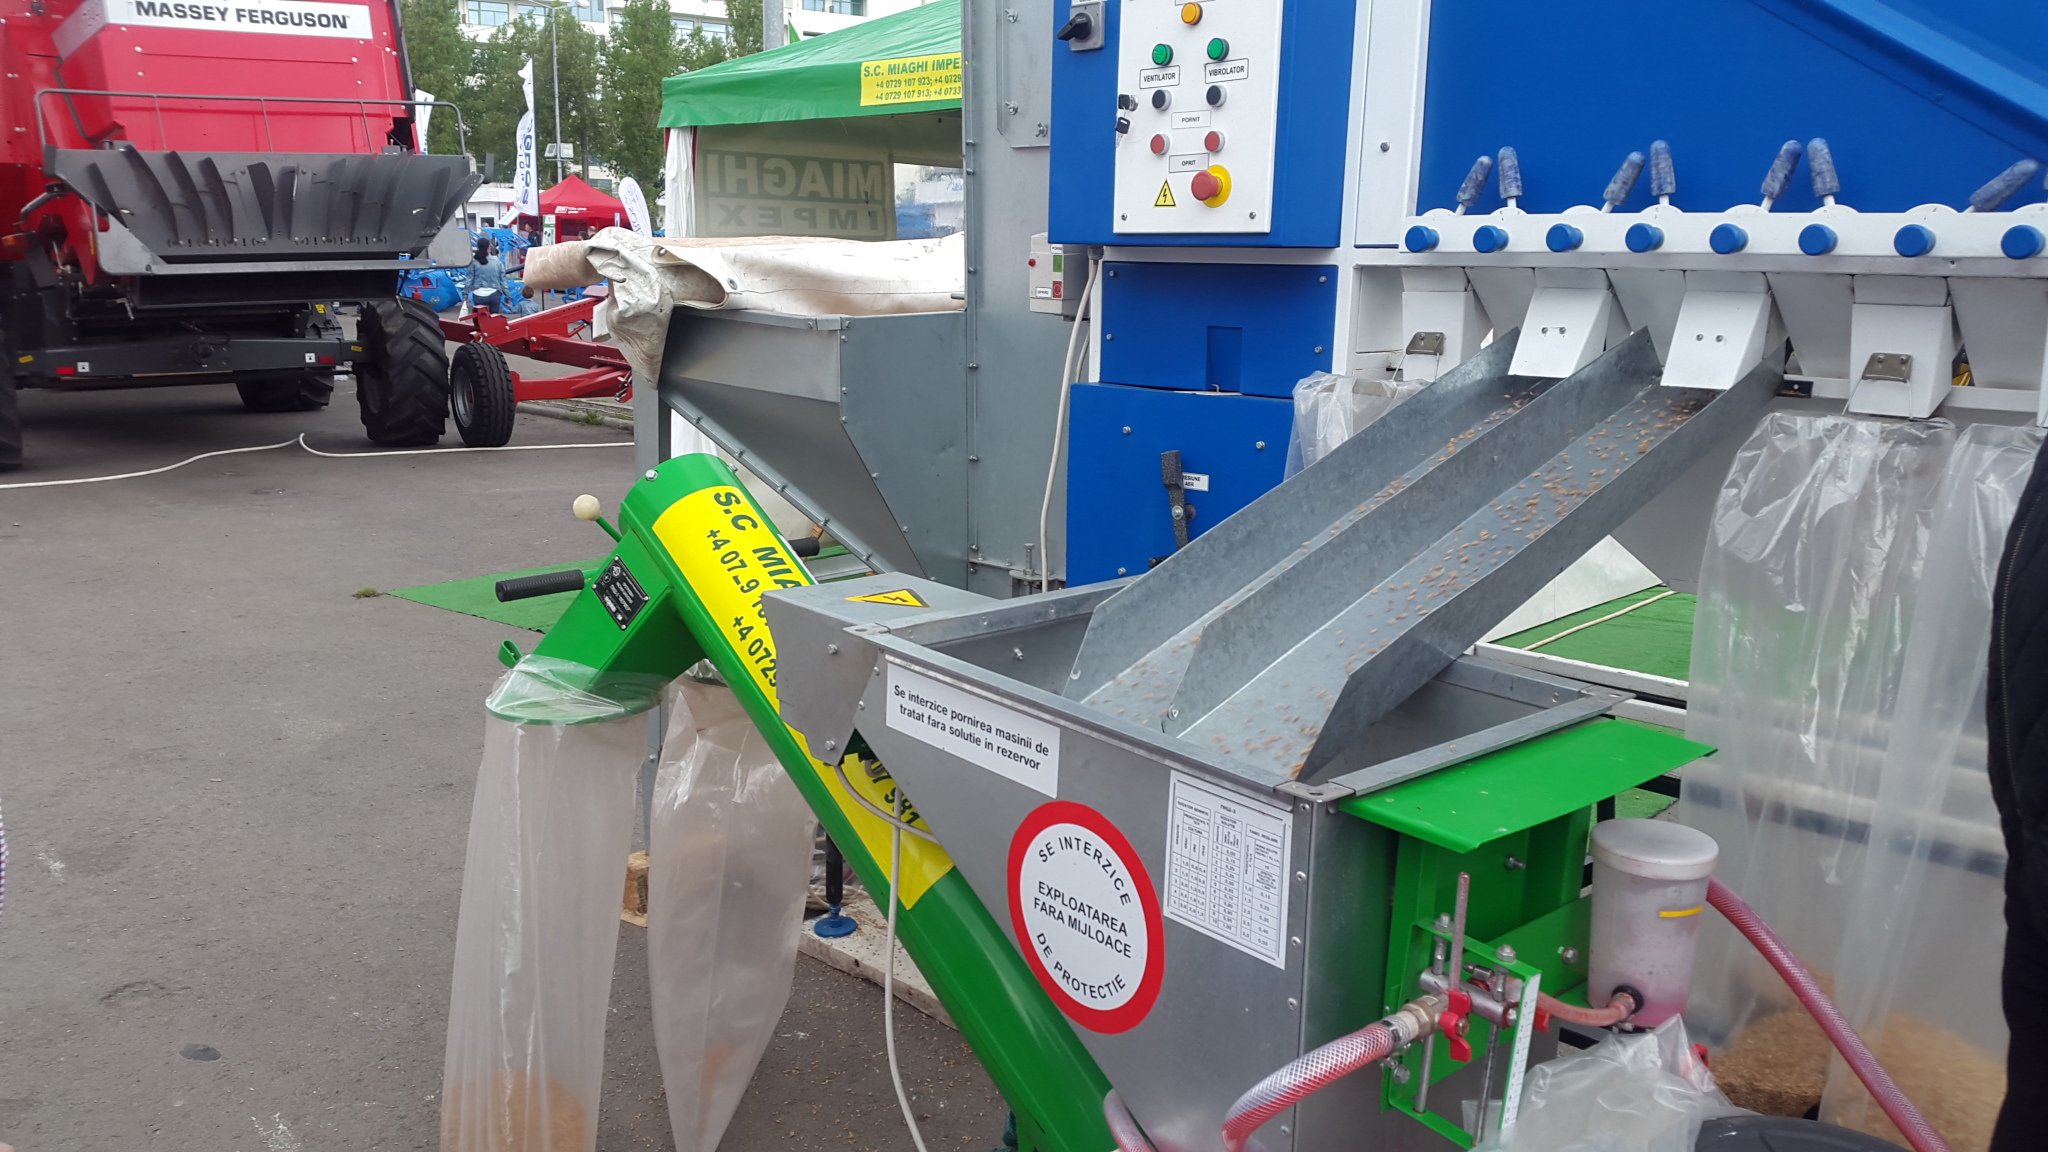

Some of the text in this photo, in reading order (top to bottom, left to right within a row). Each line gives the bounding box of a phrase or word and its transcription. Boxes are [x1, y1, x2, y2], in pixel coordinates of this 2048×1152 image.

[136, 1, 348, 29] MASSEY FERGUSON
[864, 57, 962, 77] S.C. MIAGHI IMPE
[1143, 72, 1176, 83] VENTILATOR
[1208, 65, 1245, 77] VIBROLATOR
[903, 78, 916, 87] 107
[1181, 159, 1197, 167] OPRIT
[713, 491, 759, 531] S.C
[706, 529, 731, 552] +4
[732, 615, 754, 642] +4
[894, 684, 1050, 757] Se interzice pornirea masinii de
[900, 704, 1041, 770] tratat fara solutie in rezervor
[1038, 836, 1132, 906] SE INTERZICE
[1038, 881, 1128, 937] EXPLOATAREA
[1033, 897, 1132, 959] FARA MIJLOACE
[1036, 932, 1127, 1000] DE PROTECTIE
